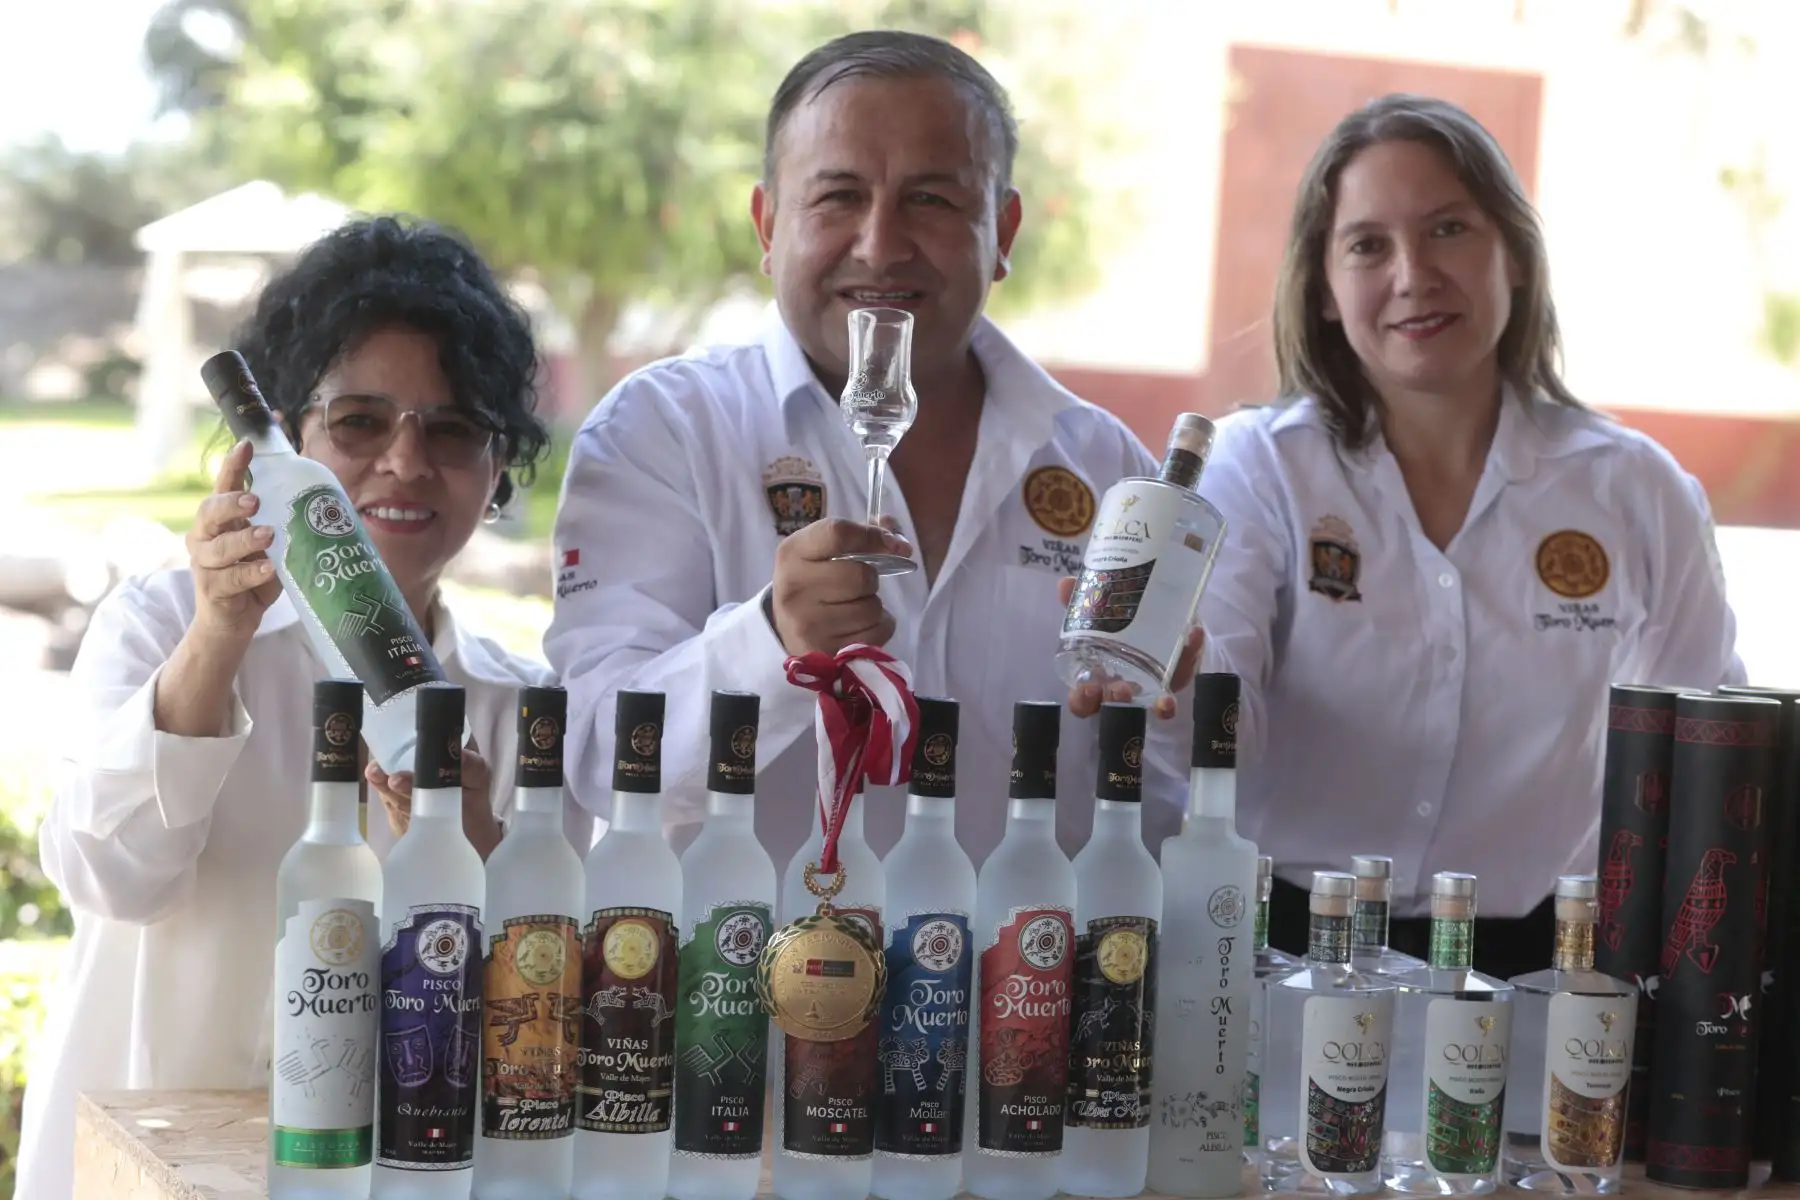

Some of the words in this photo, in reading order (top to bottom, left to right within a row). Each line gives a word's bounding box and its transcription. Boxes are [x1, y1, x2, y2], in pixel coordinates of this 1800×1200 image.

[316, 542, 376, 572] Toro
[1019, 545, 1051, 566] Toro
[1536, 613, 1571, 632] Toro
[390, 634, 413, 646] PISCO
[387, 643, 424, 659] ITALIA
[1218, 936, 1236, 989] Toro
[302, 968, 369, 994] Toro
[422, 980, 461, 991] PISCO
[1005, 974, 1066, 999] Toro
[910, 979, 965, 1006] Toro
[288, 991, 377, 1017] Muerto
[385, 989, 424, 1012] Toro
[434, 992, 481, 1013] Muert
[689, 991, 760, 1018] Muer
[994, 993, 1071, 1018] Muerto
[892, 1004, 968, 1034] Muerto
[1210, 996, 1232, 1075] Muerto
[1696, 1021, 1728, 1036] Toro
[608, 1036, 649, 1050] VIÑAS
[1104, 1040, 1141, 1051] VIÑAS
[577, 1047, 616, 1067] Toro
[616, 1051, 672, 1073] Muerto
[1322, 1041, 1387, 1064] QOLCA
[600, 1073, 618, 1081] Valle
[619, 1073, 629, 1081] de
[1096, 1074, 1114, 1082] Valle
[605, 1089, 645, 1104] Pisco
[720, 1096, 745, 1104] PISCO
[828, 1097, 853, 1106] PISCO
[1024, 1095, 1047, 1104] PISCO
[1100, 1091, 1138, 1105] Pisco
[396, 1102, 467, 1118] Quebranta
[520, 1099, 559, 1114] Pisco
[585, 1100, 661, 1123] Albilla
[711, 1105, 749, 1117] ITALIA
[806, 1105, 868, 1119] MOSCATEL
[1000, 1104, 1061, 1117] ACHOLADO
[408, 1139, 427, 1147] Valle
